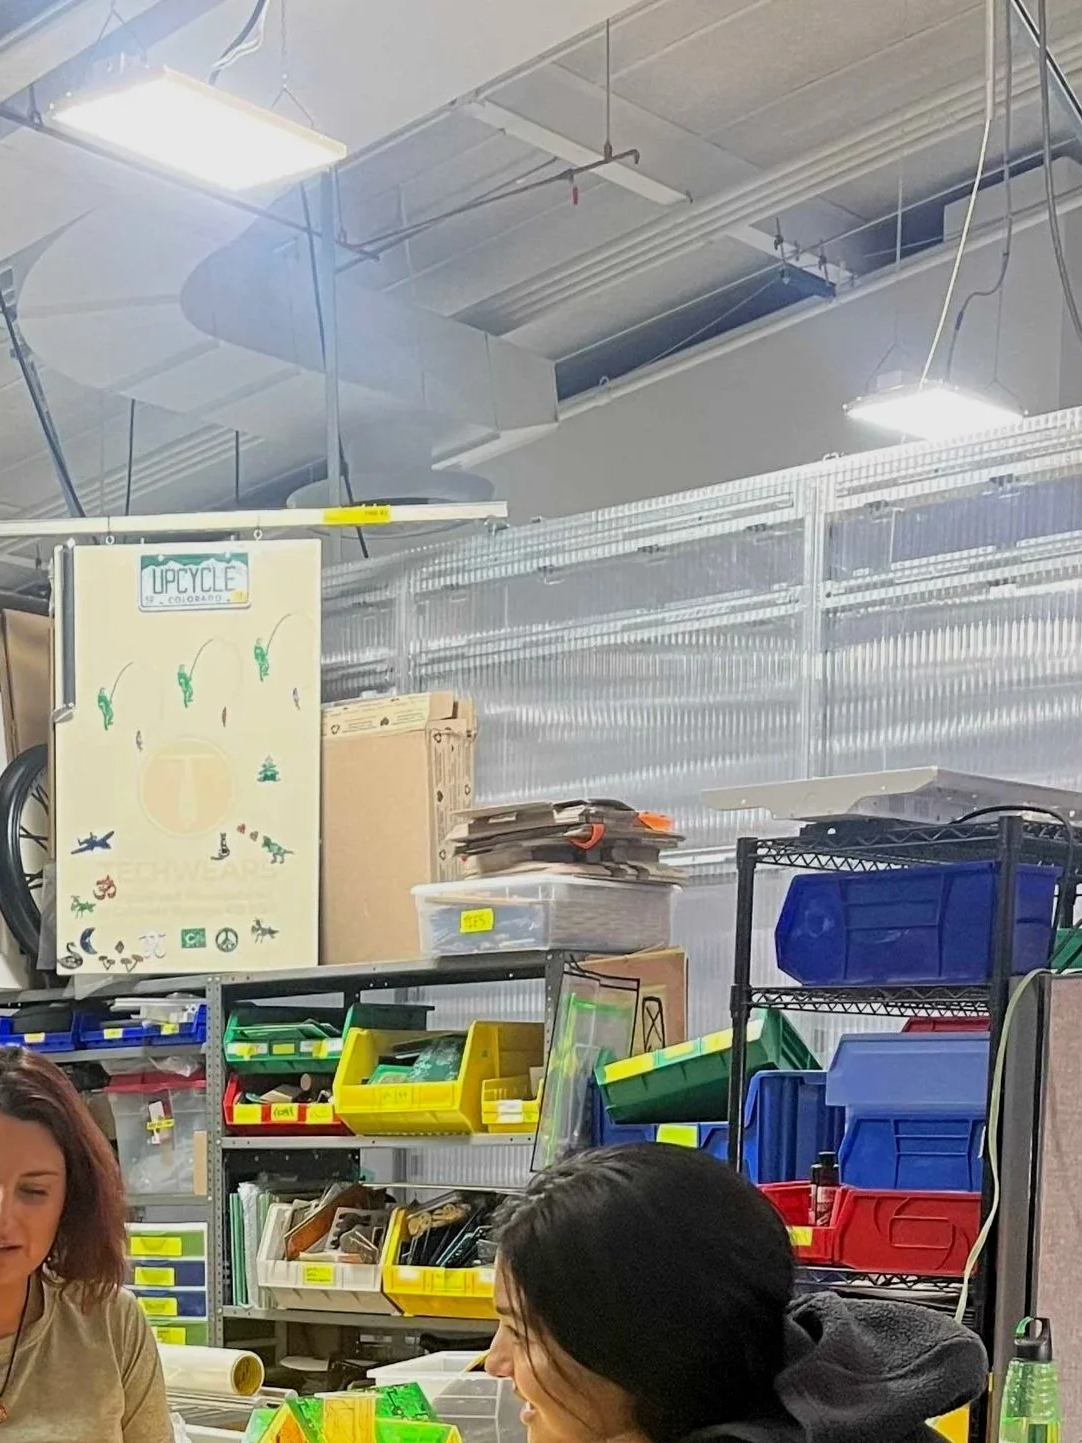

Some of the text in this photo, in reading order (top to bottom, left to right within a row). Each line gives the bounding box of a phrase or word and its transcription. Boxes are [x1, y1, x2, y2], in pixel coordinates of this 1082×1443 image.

[152, 565, 237, 594] UPCYCLE
[168, 594, 222, 605] COLORADO
[96, 859, 278, 882] TECHWEARS
